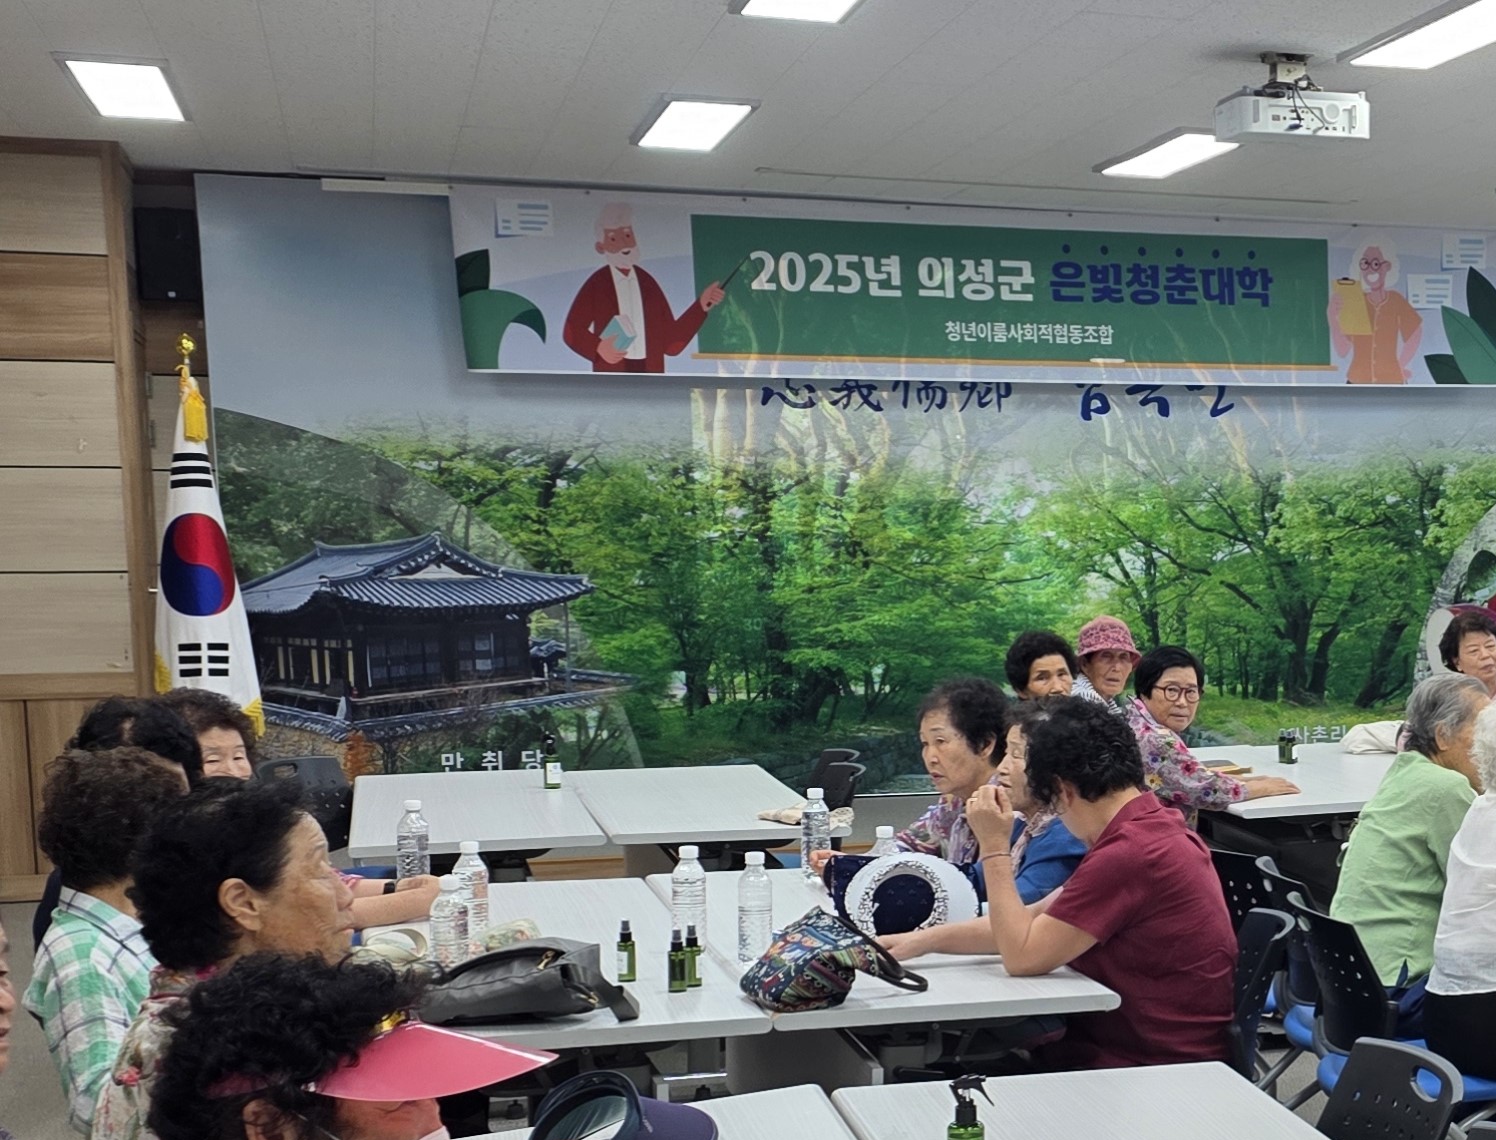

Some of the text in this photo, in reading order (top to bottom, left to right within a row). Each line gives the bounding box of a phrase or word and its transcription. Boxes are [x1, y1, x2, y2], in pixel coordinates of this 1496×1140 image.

[750, 251, 1274, 308] 2025년 의성군 은빛청춘대학
[944, 320, 1115, 345] 청년이룸사회적협동조합
